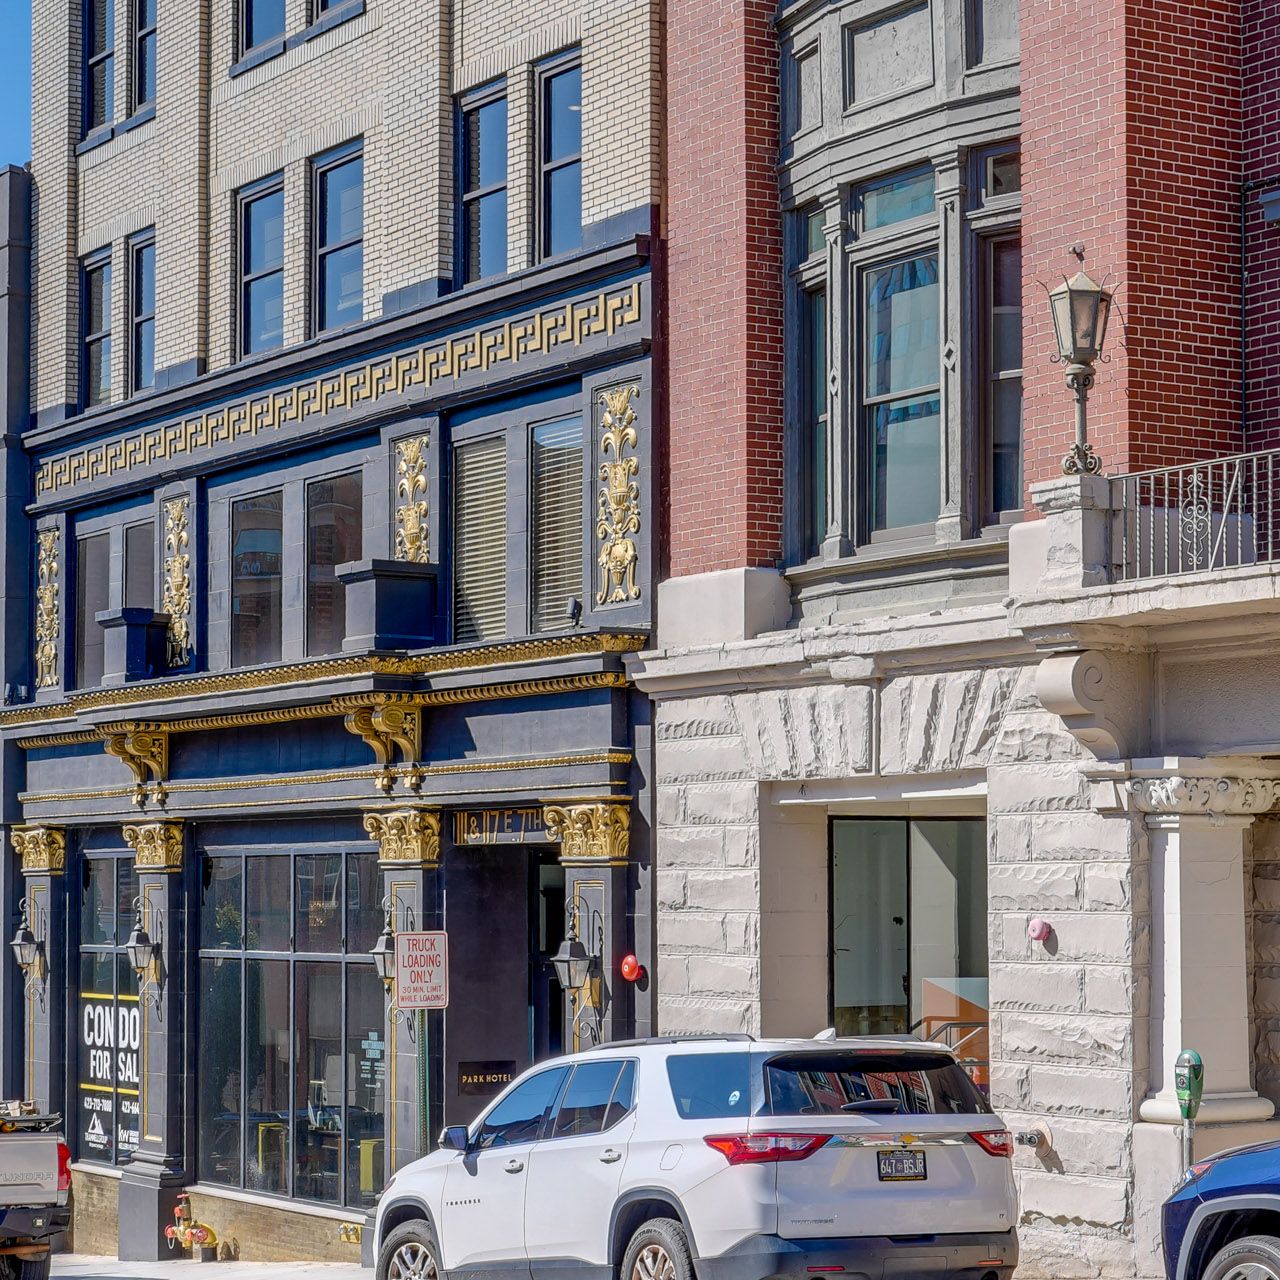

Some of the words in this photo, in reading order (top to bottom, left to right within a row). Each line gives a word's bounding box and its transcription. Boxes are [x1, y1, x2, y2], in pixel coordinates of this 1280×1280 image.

[504, 810, 512, 833] E
[406, 938, 436, 952] TRUCK
[402, 954, 441, 968] LOADING
[410, 970, 434, 984] ONLY
[402, 986, 411, 994] 30
[426, 985, 442, 993] LIMIT
[400, 995, 418, 1003] WHILE
[421, 994, 445, 1002] LOADING
[90, 1049, 111, 1080] FOR
[118, 1052, 140, 1083] SAL
[462, 1075, 484, 1083] PARK
[486, 1074, 512, 1082] HOTEL
[880, 1159, 896, 1174] 647
[903, 1159, 925, 1173] BSJR
